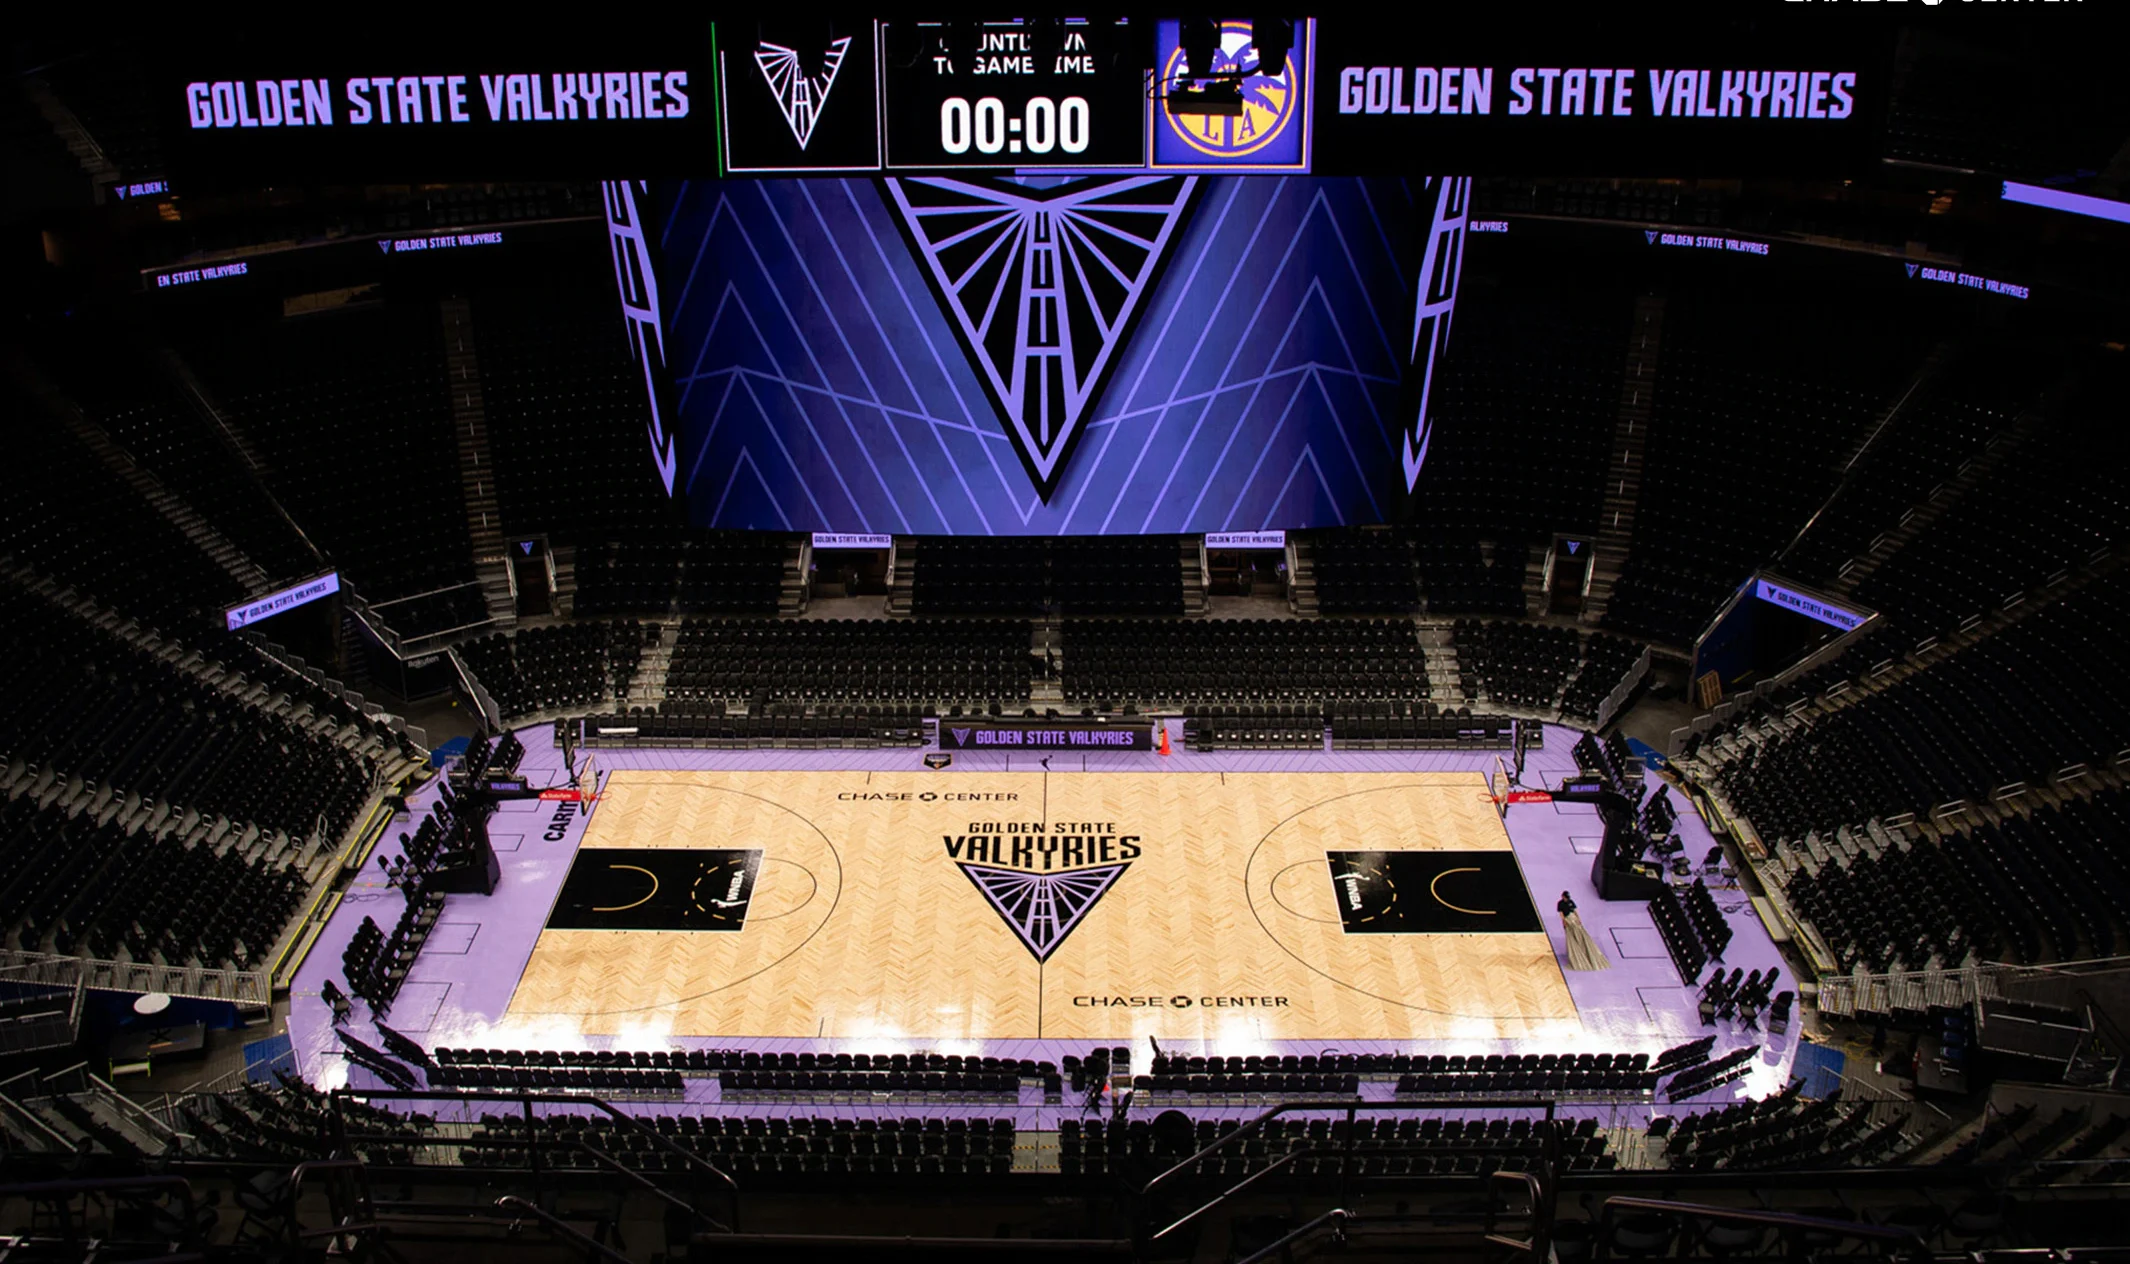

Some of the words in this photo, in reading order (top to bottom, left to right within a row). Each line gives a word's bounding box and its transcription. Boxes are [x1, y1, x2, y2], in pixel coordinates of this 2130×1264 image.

[973, 56, 1035, 75] GAME
[1054, 56, 1095, 75] IME
[187, 79, 333, 129] GOLDEN
[346, 76, 470, 125] STATE
[480, 71, 690, 122] VALKYRIES
[1339, 67, 1493, 115] GOLDEN
[1509, 68, 1635, 117] STATE
[1649, 69, 1857, 119] VALKYRIES
[941, 96, 1090, 154] 00:00
[130, 181, 162, 197] GOLDEN
[1469, 221, 1508, 232] ALKYRIES
[395, 238, 428, 252] GOLDEN
[430, 236, 457, 249] STATE
[458, 232, 502, 246] VALKYRIES
[1661, 233, 1694, 246] GOLDEN
[1695, 236, 1723, 249] STATE
[1725, 239, 1769, 255] VALKYRIES
[172, 270, 200, 285] STATE
[201, 262, 248, 280] VALKYRIES
[1921, 267, 1956, 284] GOLDEN
[1957, 274, 1984, 290] STATE
[1985, 279, 2029, 299] VALKYRIES
[814, 535, 837, 543] GOLDEN
[838, 535, 857, 543] STATE
[858, 535, 890, 543] VALKYRIES
[1207, 535, 1230, 543] GOLDEN
[1231, 535, 1250, 543] STATE
[1252, 535, 1284, 543] VALKYRIES
[250, 602, 274, 617] GOLDEN
[274, 596, 295, 609] STATE
[295, 582, 327, 601] VALKYRIES
[1778, 591, 1801, 607] GOLDEN
[1802, 601, 1822, 614] STATE
[1823, 608, 1857, 627] VALKYRIES
[975, 730, 1023, 745] GOLDEN
[1026, 730, 1066, 745] STATE
[1069, 730, 1134, 745] VALKYRIES
[837, 792, 913, 802] CHASE
[944, 792, 1019, 802] CENTER
[968, 822, 1045, 834] GOLDEN
[1055, 822, 1116, 834] STATE
[942, 835, 1142, 871] VALKYRIES
[726, 869, 746, 902] WNBA
[1345, 878, 1363, 911] WNBA
[1072, 996, 1164, 1008] CHASE
[1200, 996, 1289, 1008] CENTER
